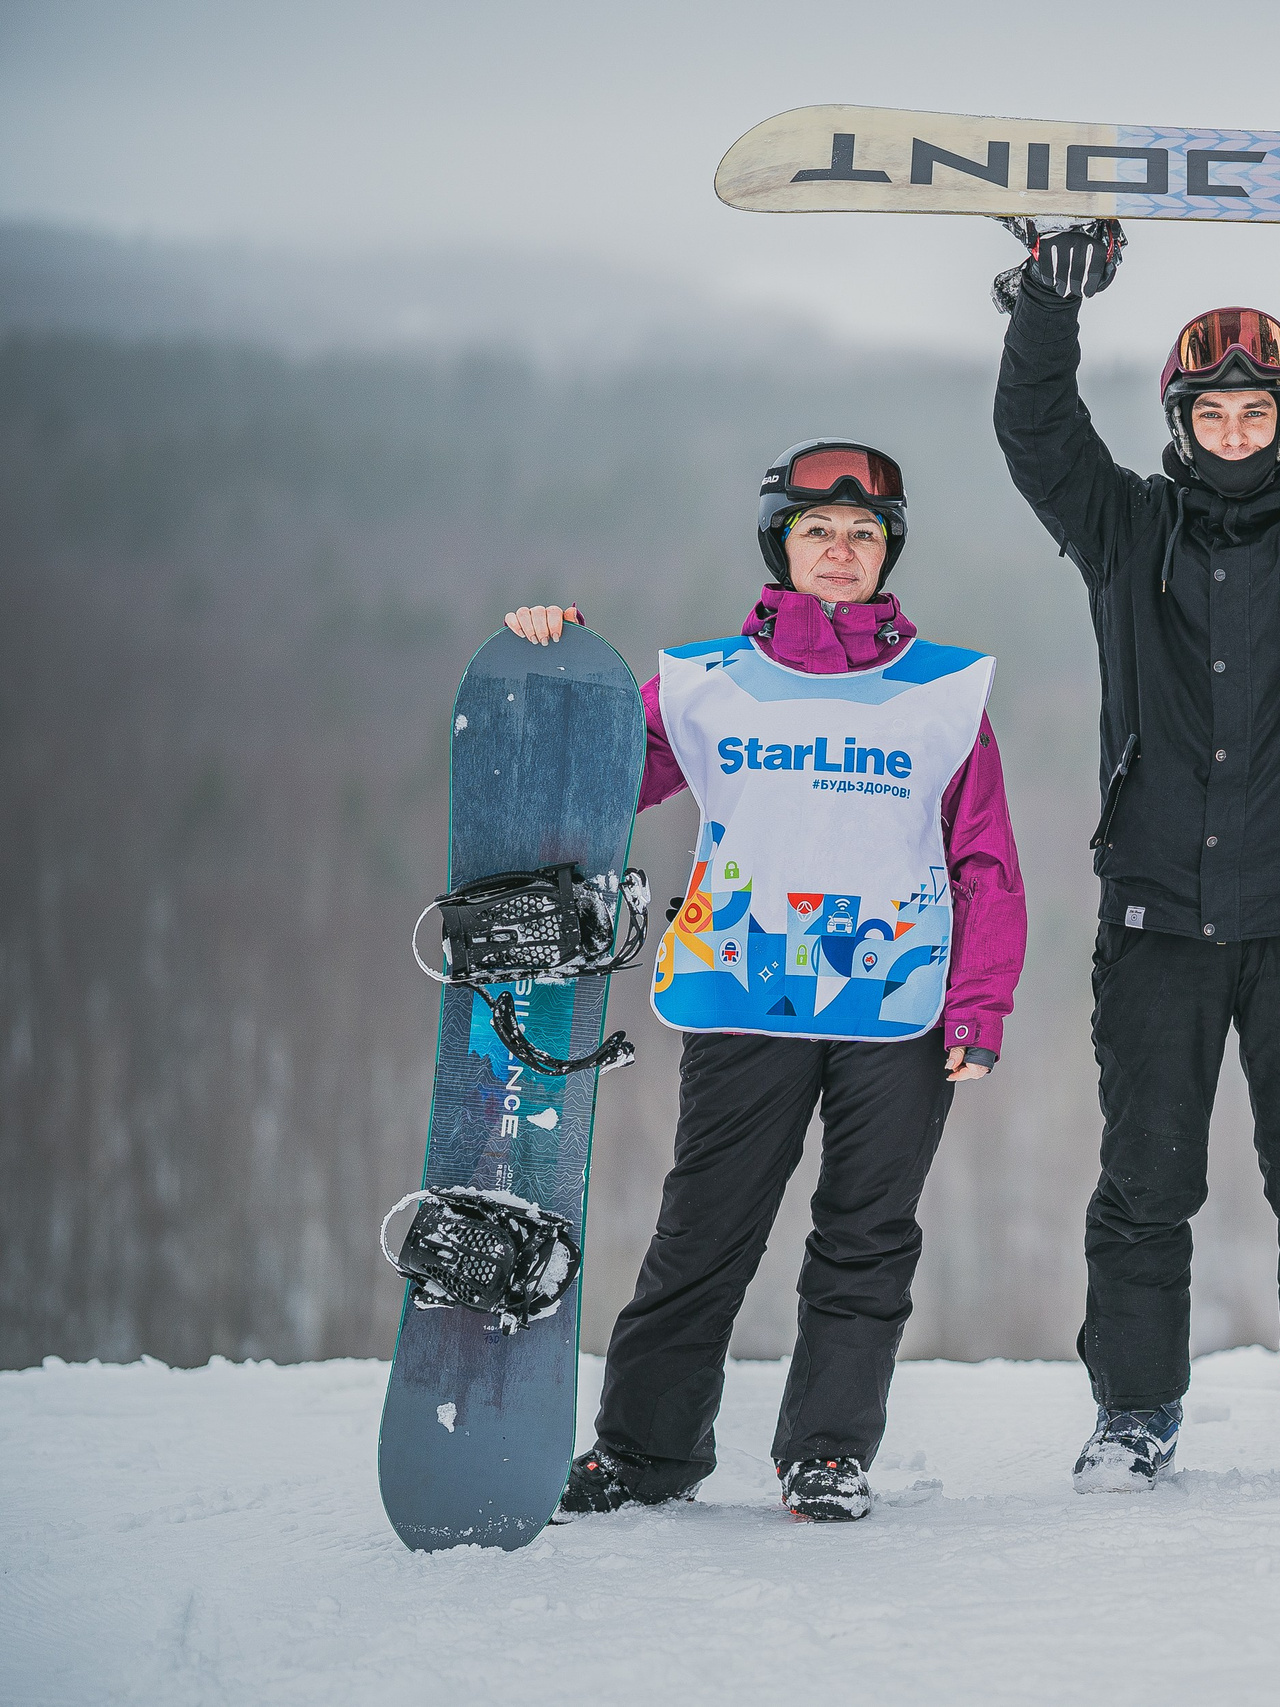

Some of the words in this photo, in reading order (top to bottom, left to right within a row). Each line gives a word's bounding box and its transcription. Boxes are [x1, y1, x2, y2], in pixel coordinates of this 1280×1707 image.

[788, 132, 1268, 198] JOINT
[761, 474, 780, 486] EAD
[717, 736, 913, 779] StarLine
[812, 778, 911, 800] #БУДЬЗДОРОВ!
[500, 979, 533, 1140] SILNCE
